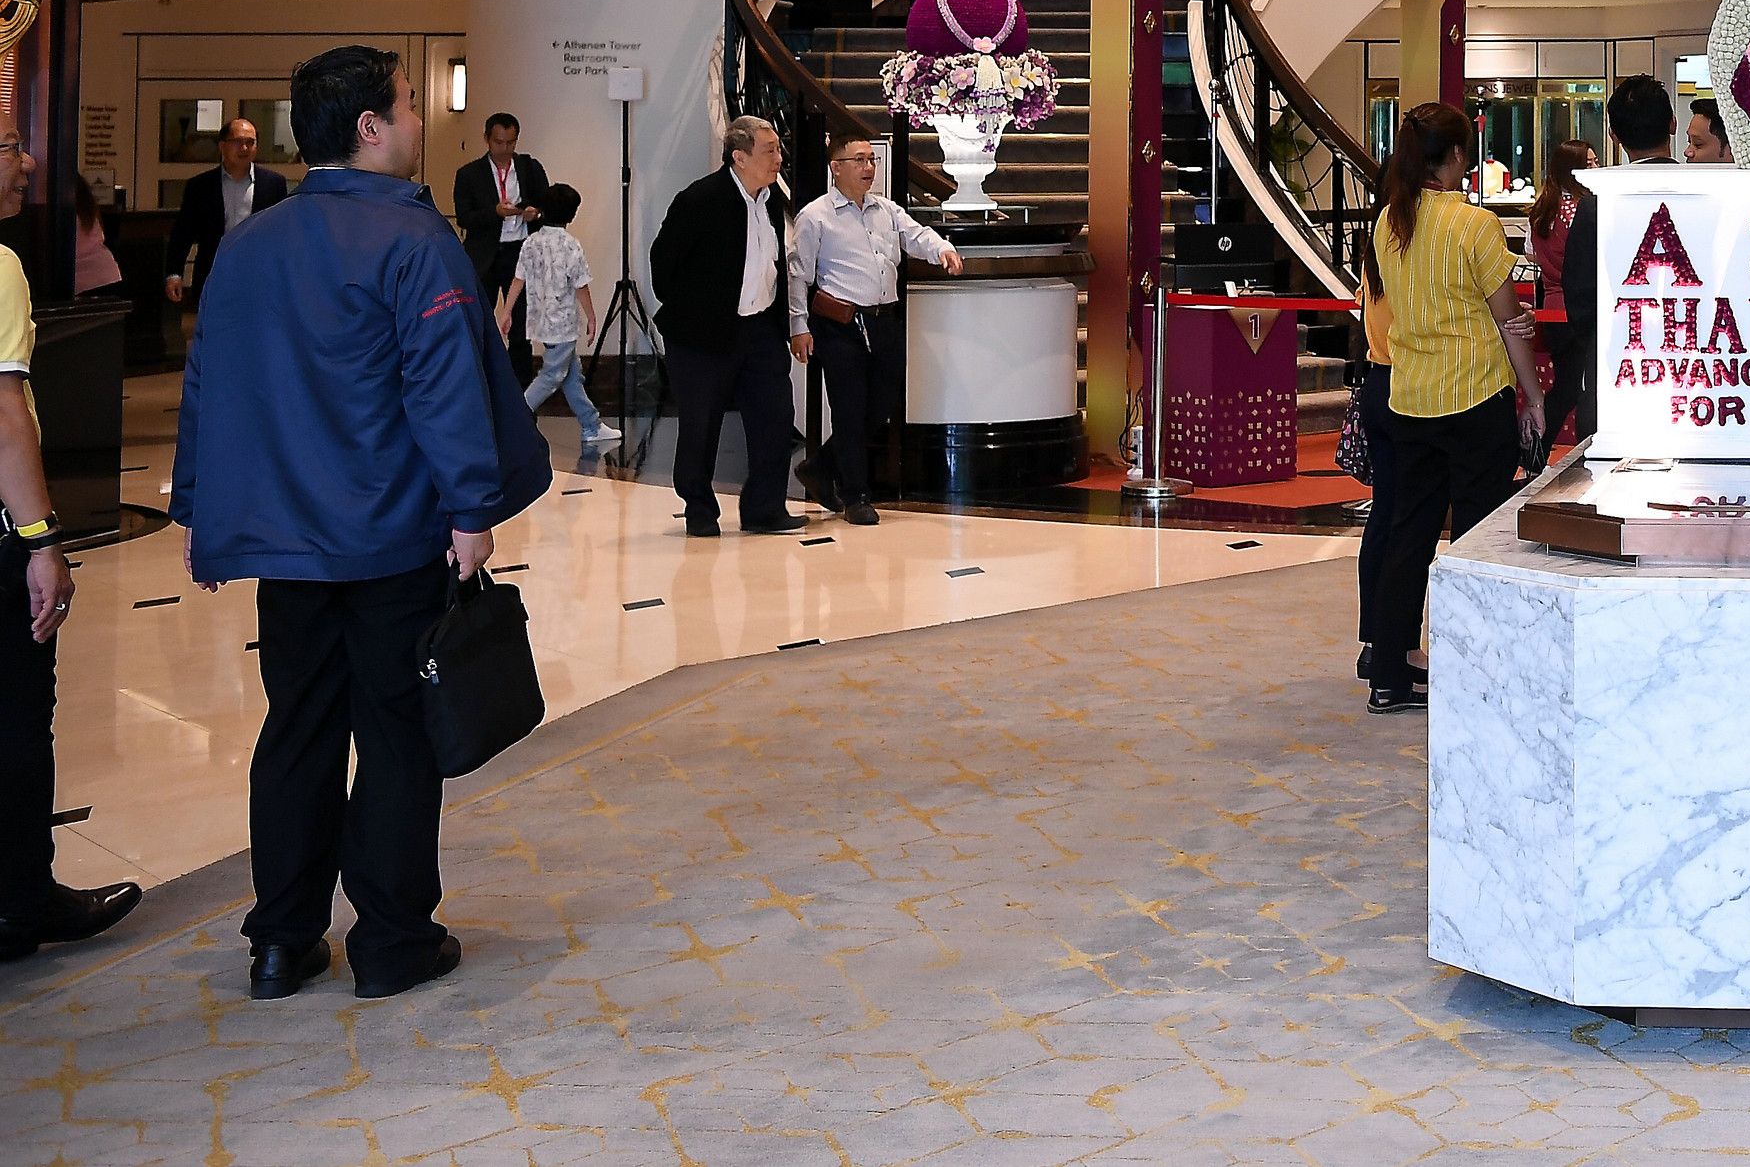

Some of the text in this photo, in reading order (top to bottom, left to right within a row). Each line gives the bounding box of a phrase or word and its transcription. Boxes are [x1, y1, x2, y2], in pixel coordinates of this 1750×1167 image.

[563, 66, 609, 75] Car Park
[1218, 236, 1232, 252] hp
[1248, 313, 1259, 339] 1
[1670, 395, 1747, 426] FOR
